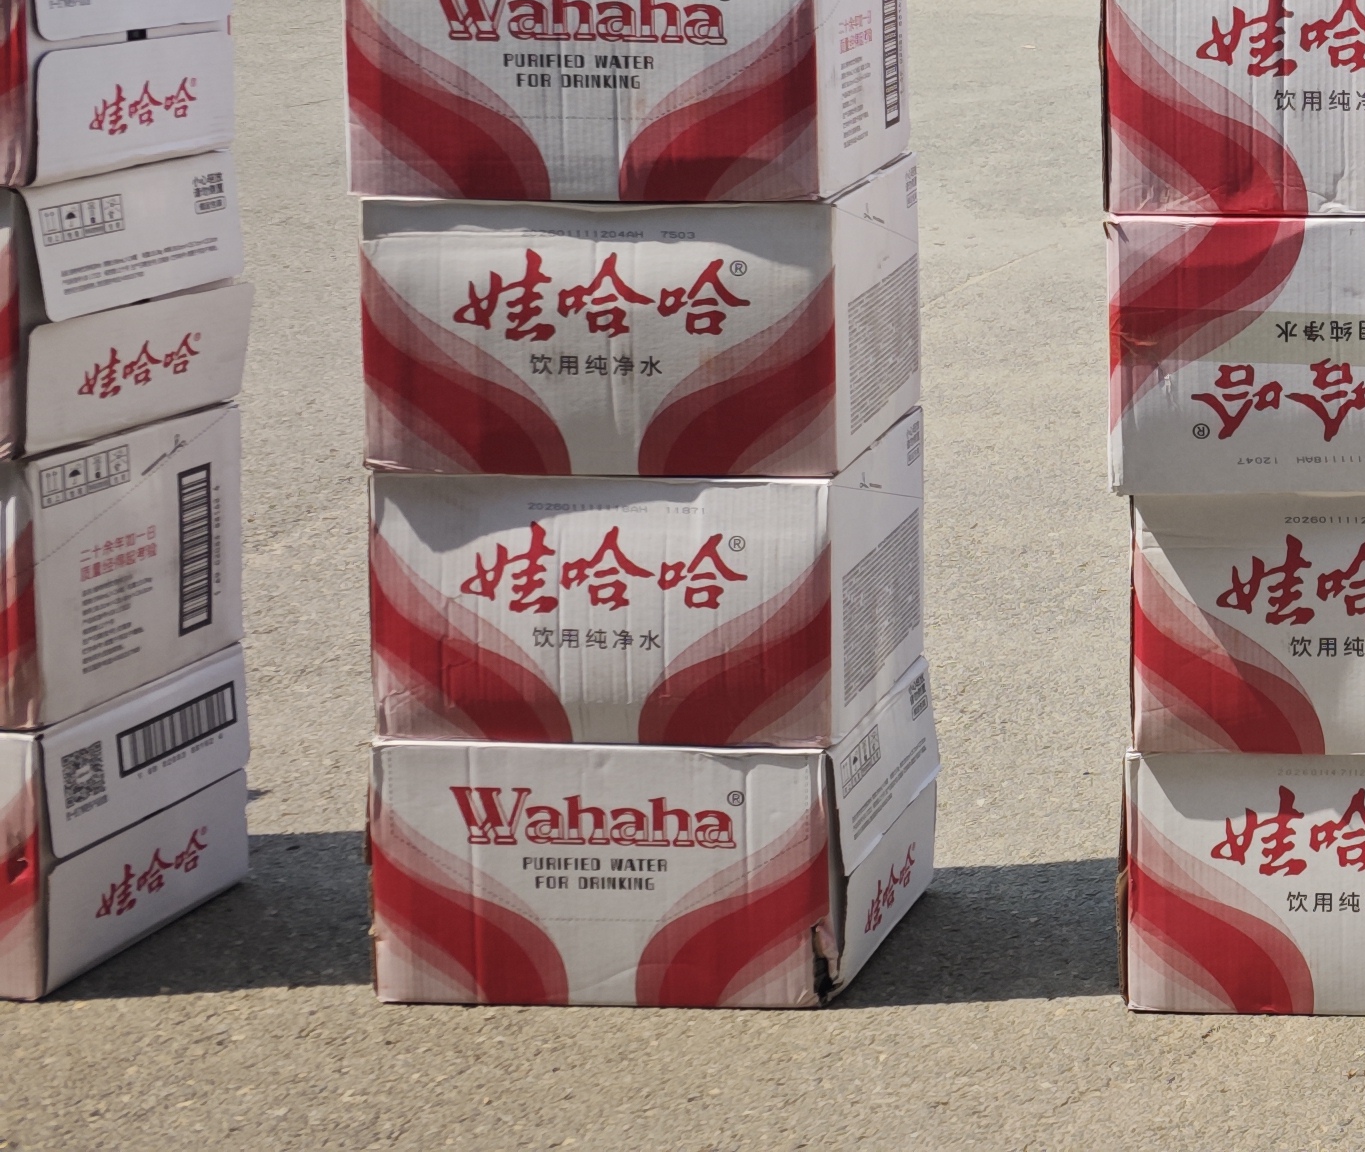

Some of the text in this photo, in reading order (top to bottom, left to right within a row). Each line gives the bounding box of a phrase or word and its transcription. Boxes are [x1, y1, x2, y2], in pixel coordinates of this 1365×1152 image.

[503, 53, 655, 71] PURIFIED WATER
[516, 73, 640, 90] FOR DRINKING
[89, 76, 197, 136] 娃哈哈
[661, 230, 696, 240] 7503
[453, 248, 752, 342] 娃哈哈
[78, 333, 200, 399] 娃哈哈
[530, 354, 663, 378] 饮用纯净水
[1236, 455, 1278, 466] 12047
[459, 520, 748, 615] 娃哈哈
[532, 627, 662, 651] 饮用纯净水
[449, 786, 737, 849] Wahaha
[95, 829, 208, 918] 娃哈哈
[522, 856, 669, 873] PURIFIED WATER
[534, 875, 655, 892] FOR DRINKING
[864, 848, 915, 934] 娃哈哈
